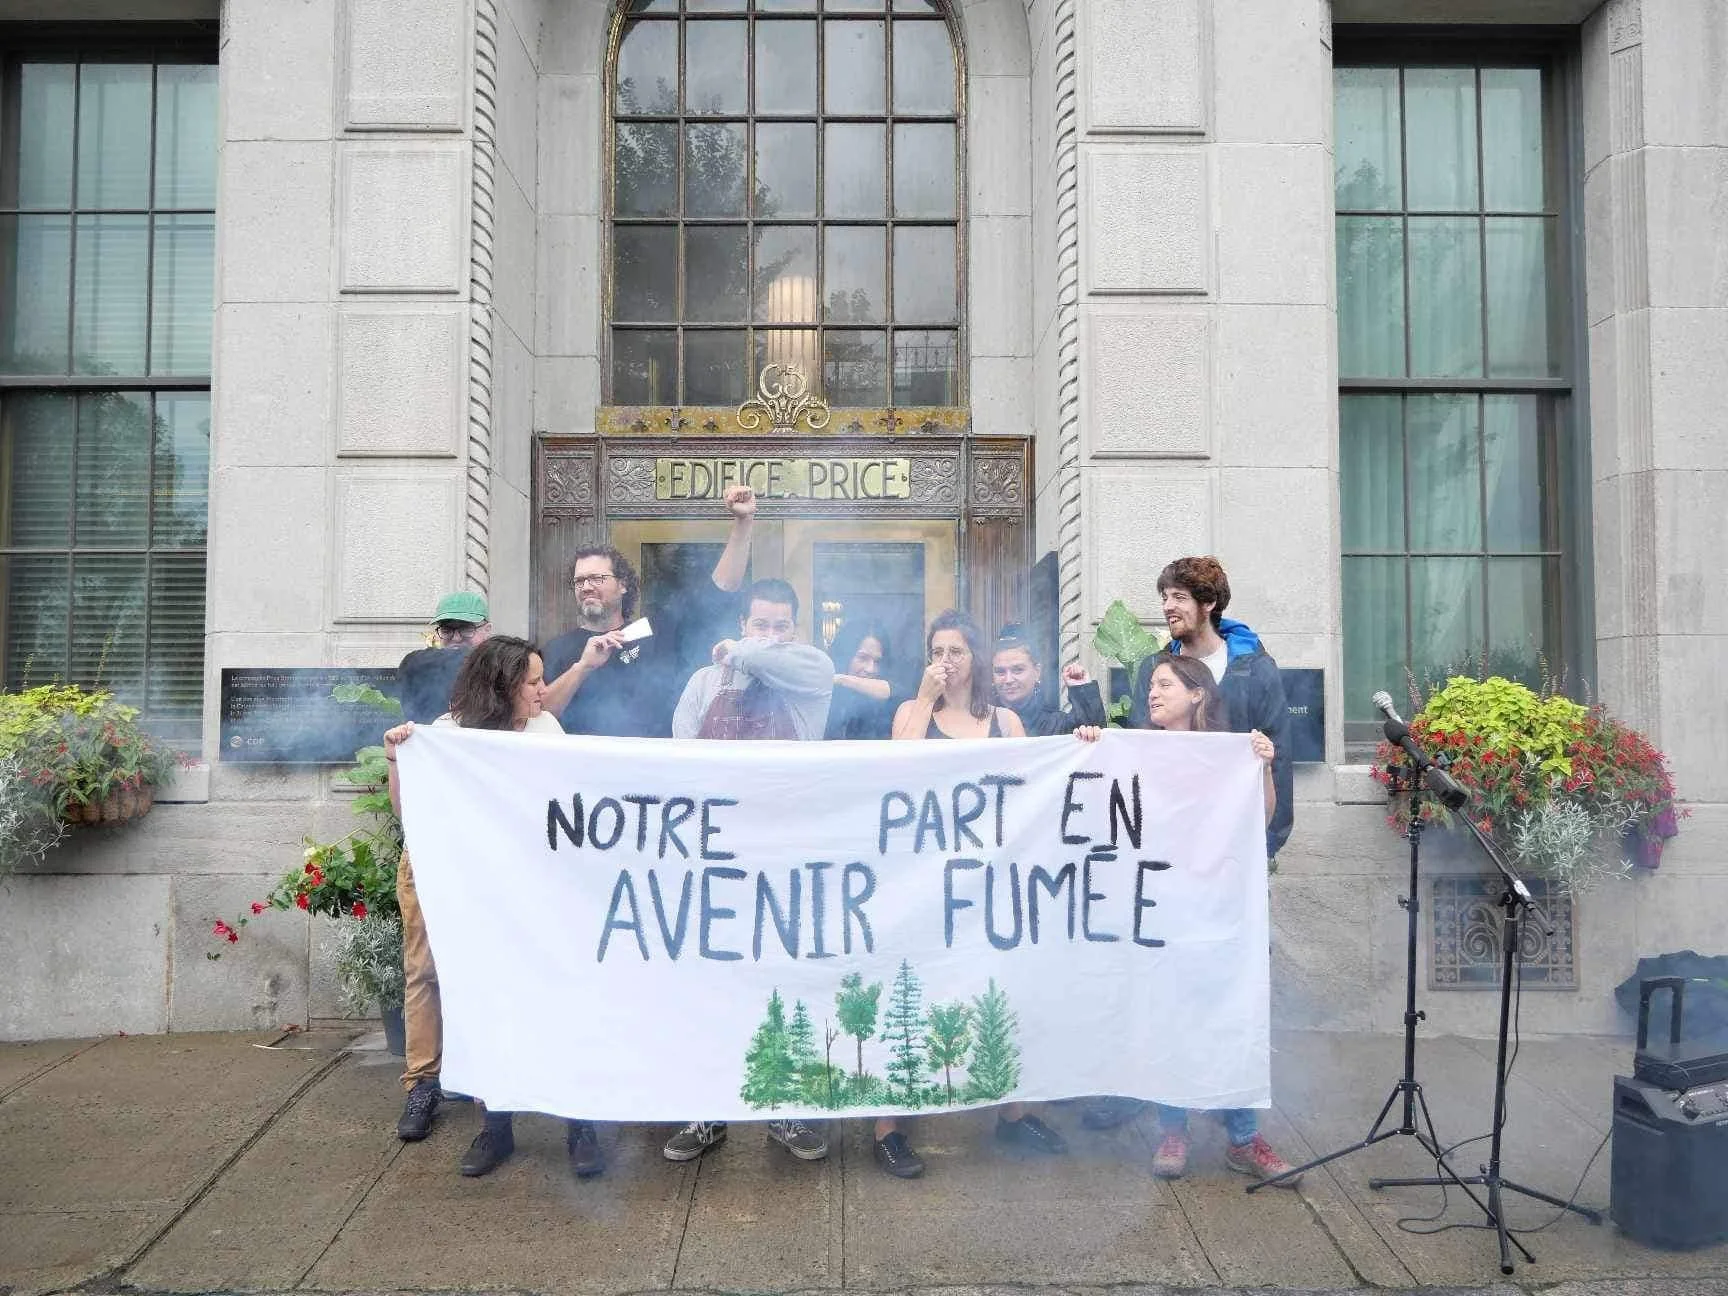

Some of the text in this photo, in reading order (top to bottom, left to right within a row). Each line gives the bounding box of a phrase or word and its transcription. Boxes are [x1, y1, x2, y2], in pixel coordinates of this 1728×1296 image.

[670, 461, 899, 499] EDIFICE PRICE
[546, 771, 1143, 861] NOTRE PART EN
[596, 844, 1175, 963] AVENIR FUMÉE
